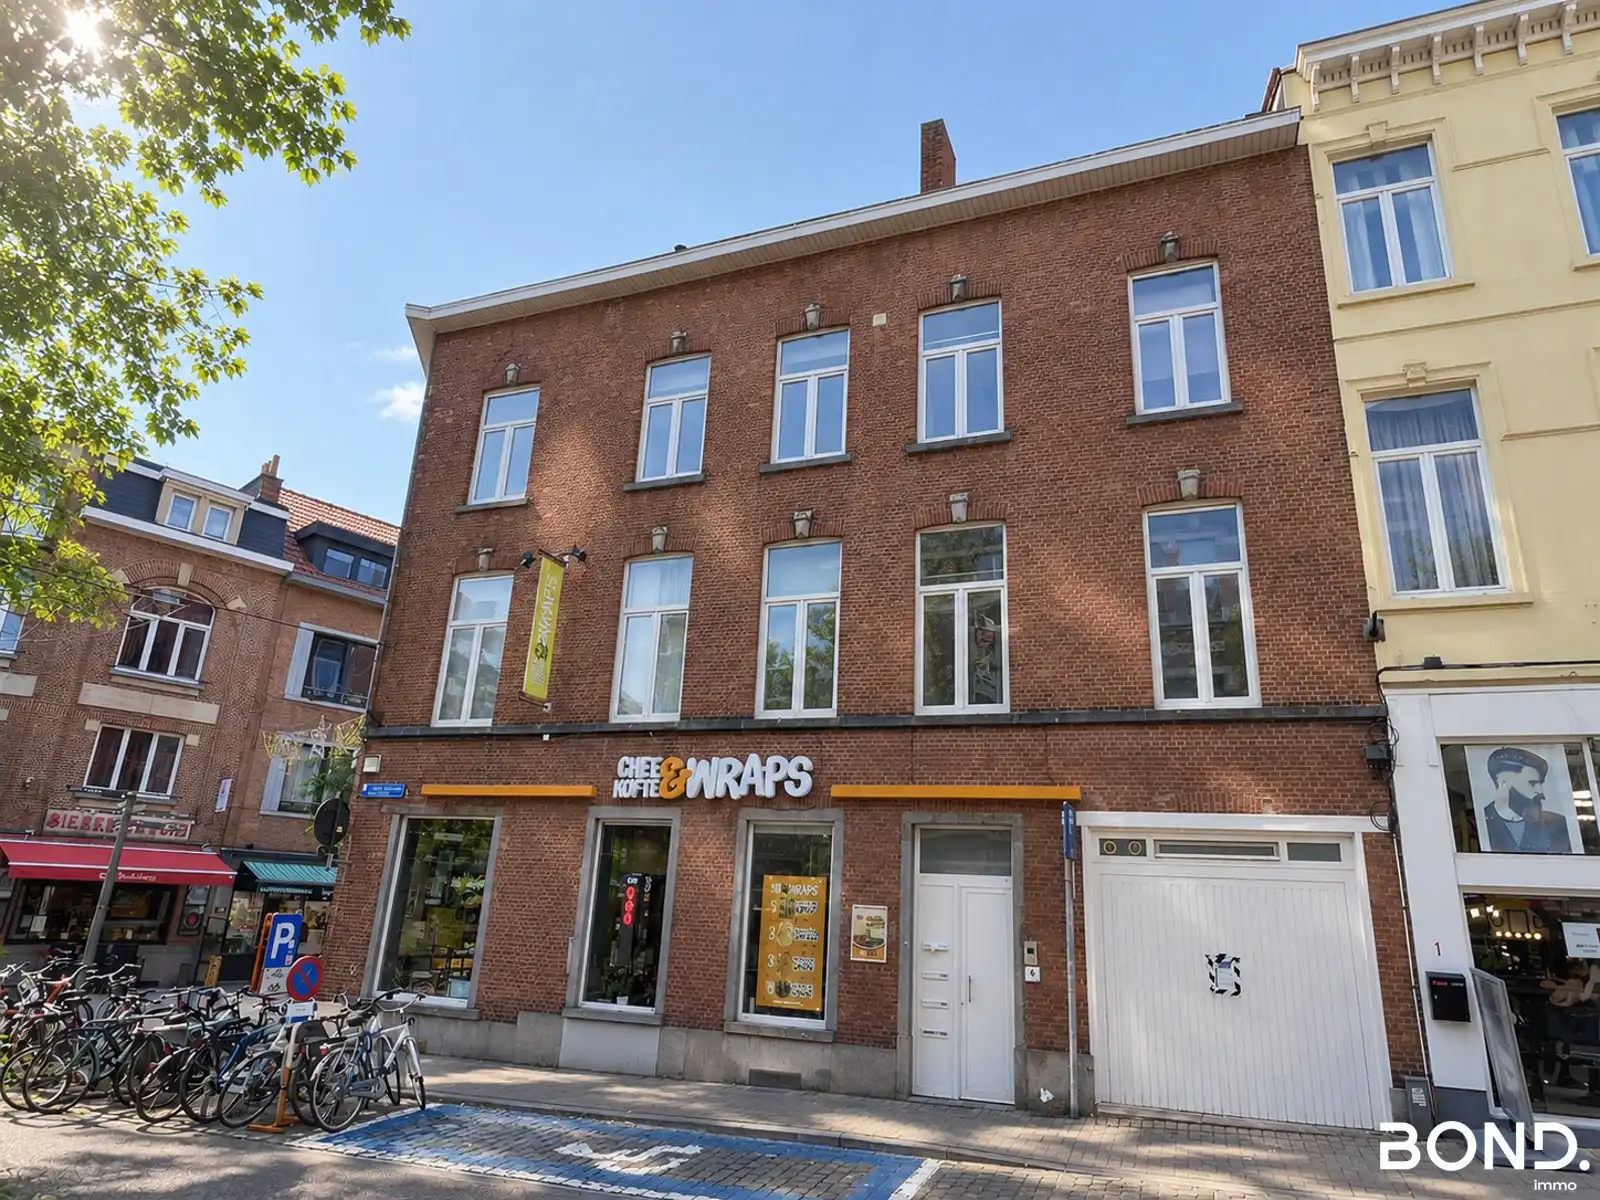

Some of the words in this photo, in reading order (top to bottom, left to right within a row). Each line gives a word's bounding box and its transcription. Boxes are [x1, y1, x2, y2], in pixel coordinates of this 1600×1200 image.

[617, 756, 664, 778] CHEE
[686, 753, 814, 800] WRAPS
[271, 922, 295, 958] P
[1434, 941, 1441, 957] 1
